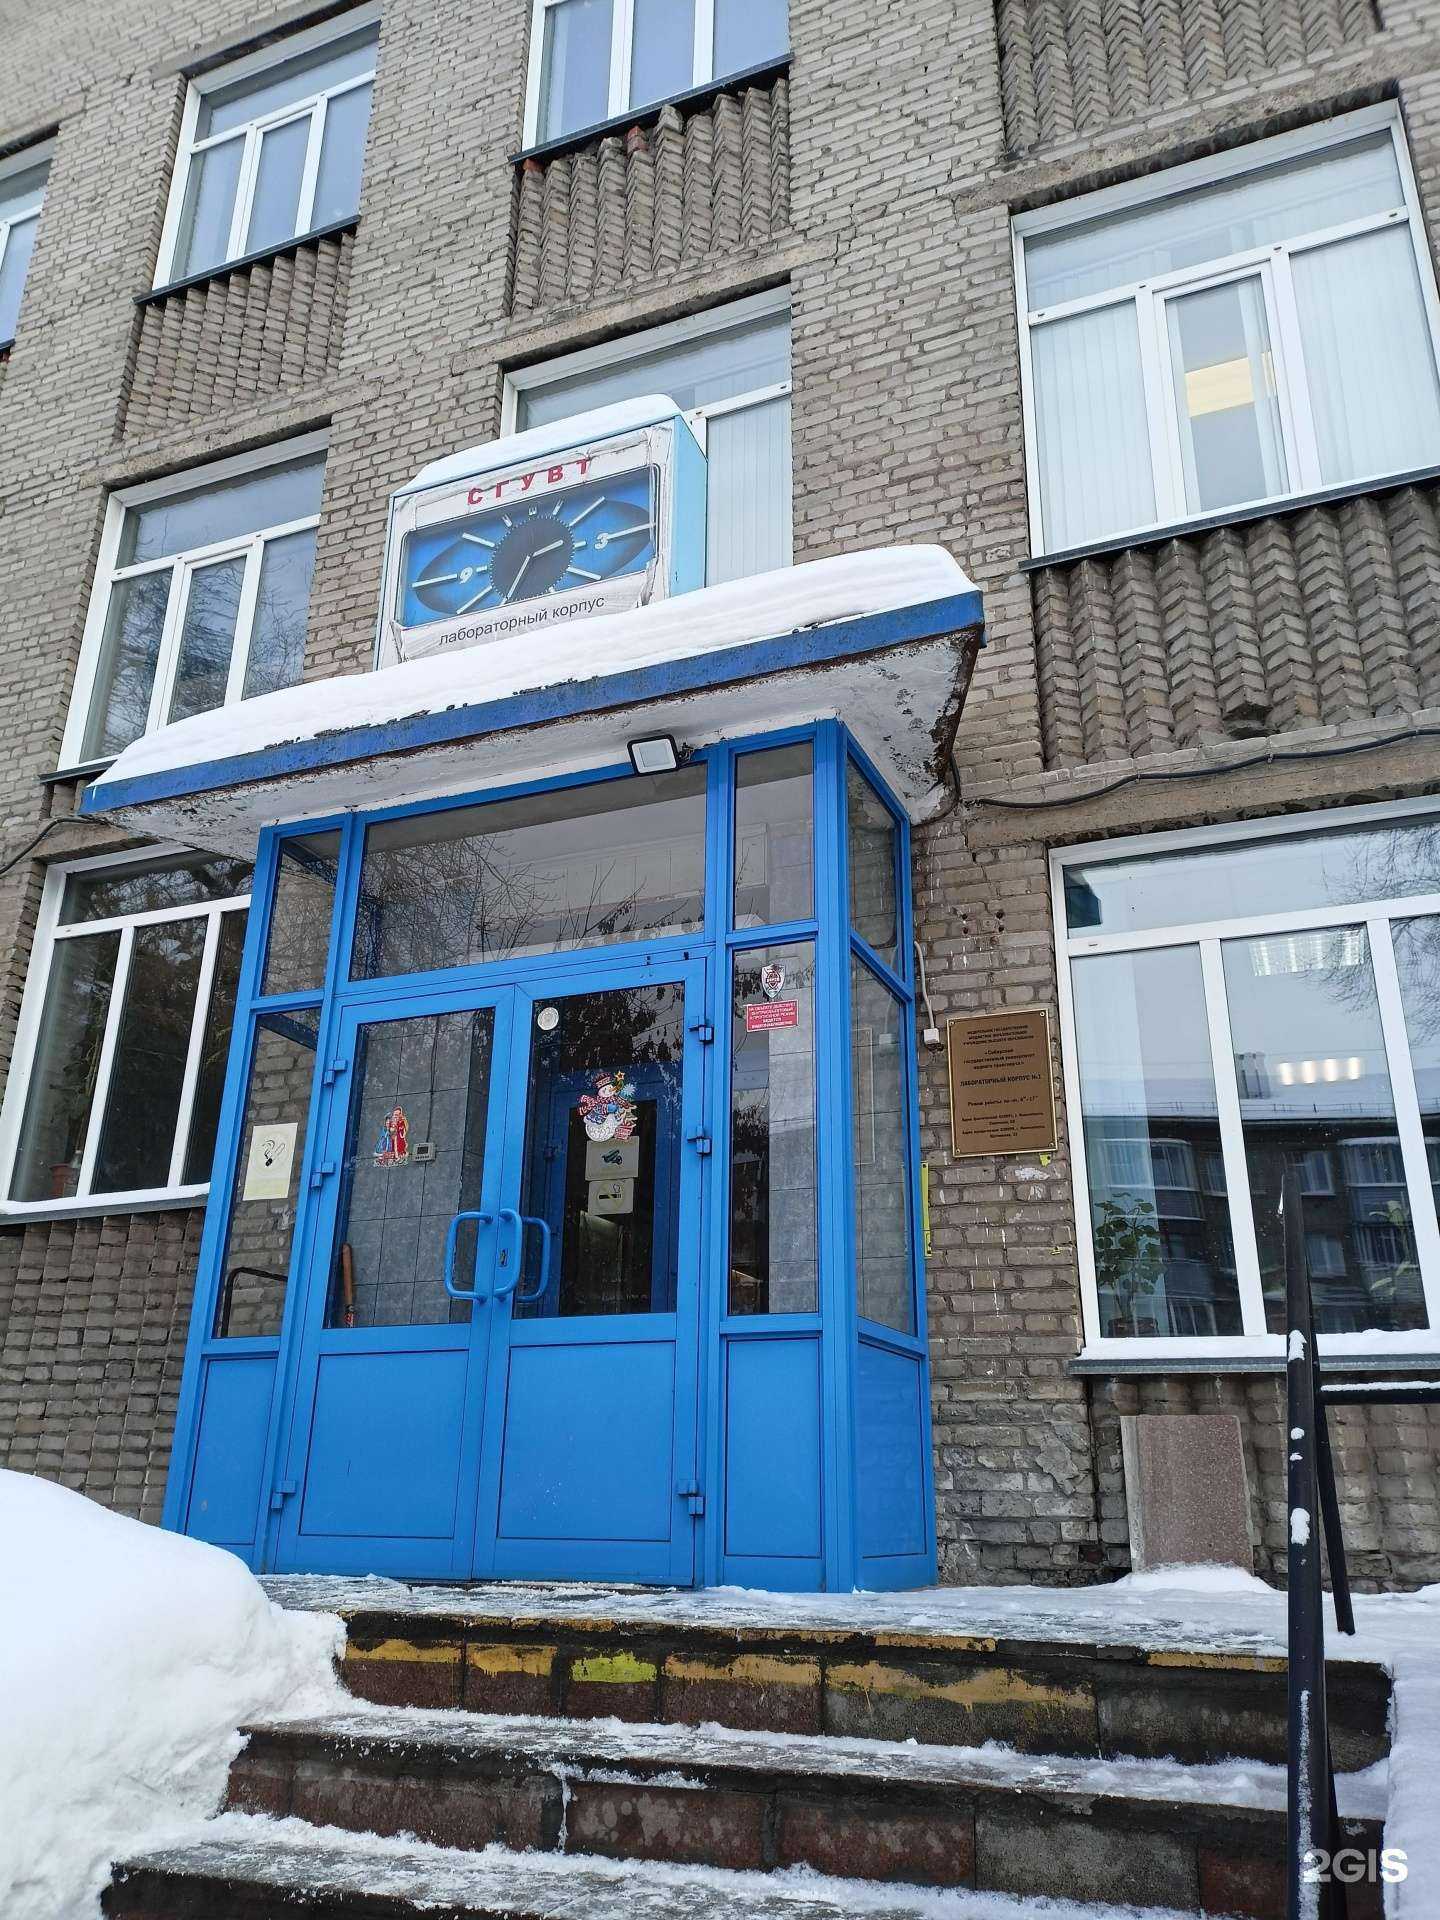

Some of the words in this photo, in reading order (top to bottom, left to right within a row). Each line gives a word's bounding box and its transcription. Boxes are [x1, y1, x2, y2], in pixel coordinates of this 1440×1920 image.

[467, 459, 591, 505] СГУВТ
[439, 610, 548, 646] лабораторный
[552, 597, 605, 621] корпус
